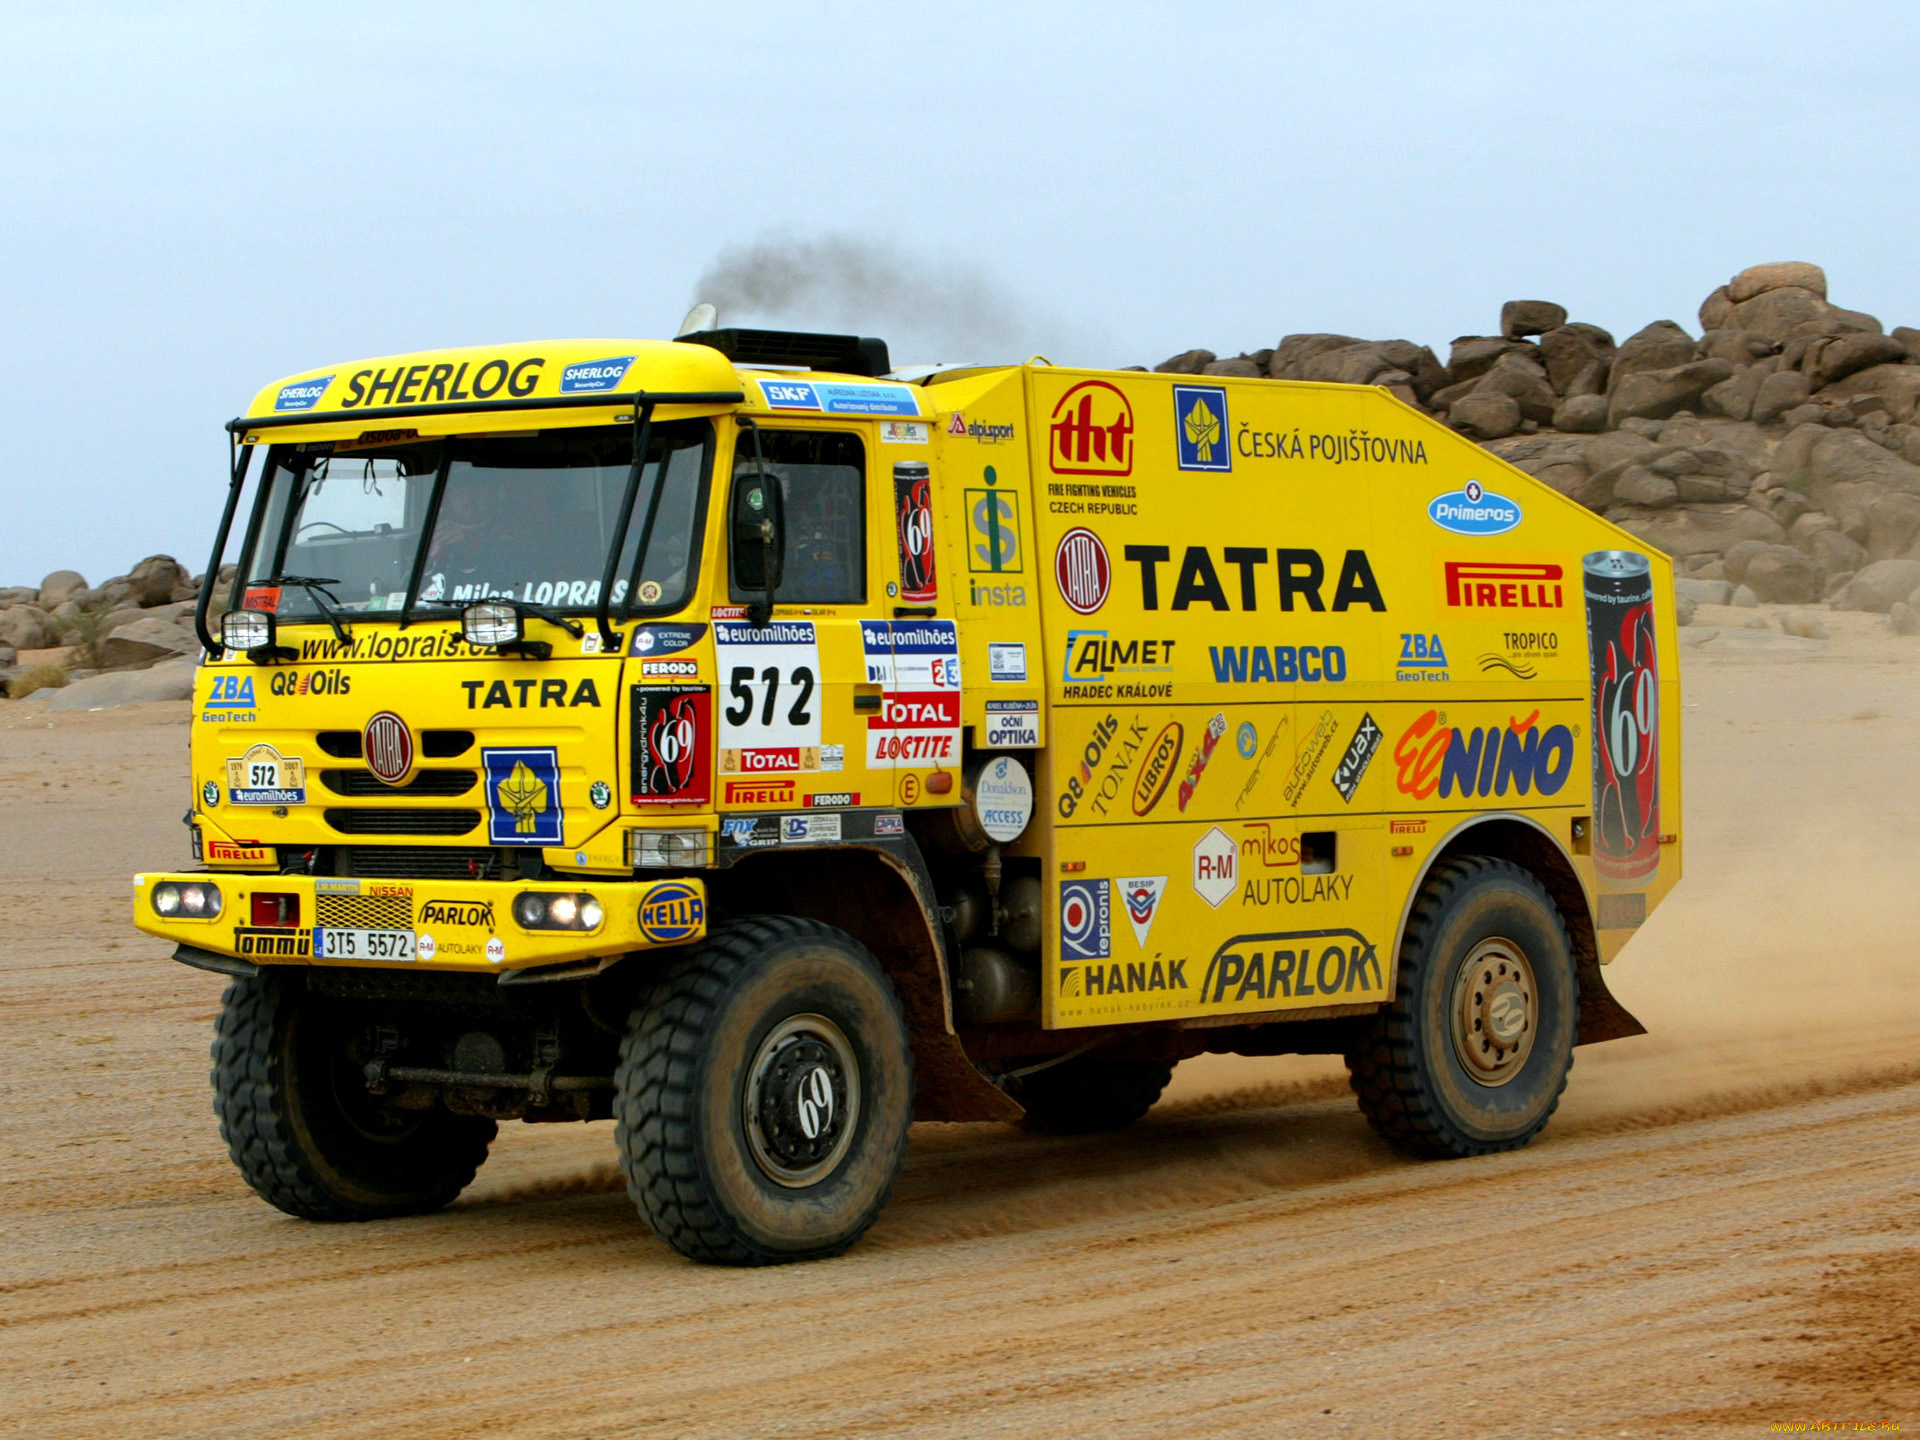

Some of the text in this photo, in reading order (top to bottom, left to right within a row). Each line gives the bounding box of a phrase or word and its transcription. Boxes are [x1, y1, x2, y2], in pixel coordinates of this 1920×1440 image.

[341, 358, 545, 408] SHERLOG
[564, 366, 624, 380] SHERLOG
[279, 386, 323, 399] SHERLOG
[768, 386, 810, 401] SKF
[1238, 422, 1428, 465] ČESKÁ POJIŠŤOVNA
[1048, 484, 1136, 498] FIRE FIGHTING VEHICLES
[1049, 501, 1138, 515] CZECH REPUBLIC
[1436, 503, 1514, 522] Primeros
[907, 508, 931, 555] 69
[1065, 537, 1100, 606] TATRA
[1124, 545, 1388, 613] TATRA
[970, 579, 1026, 606] insta
[1444, 561, 1564, 608] PIRELLI
[711, 607, 745, 618] LOCTITE
[658, 631, 691, 640] EXTREME
[730, 625, 814, 642] euromilhões
[876, 629, 955, 645] euromilhões
[1503, 632, 1558, 650] TROPICO
[1074, 640, 1176, 673] ALMET
[1399, 634, 1446, 660] ZBA
[642, 663, 697, 674] FERODO
[934, 666, 944, 683] 2
[1208, 646, 1347, 683] WABCO
[1396, 670, 1450, 681] GeoTech
[208, 676, 257, 702] ZBA
[271, 669, 351, 696] Q8 Oils
[461, 678, 602, 709] TATRA
[1063, 682, 1173, 699] HRADEC KRÁLOVÉ
[725, 667, 814, 726] 512
[202, 711, 256, 722] GeoTech
[881, 700, 952, 722] TOTAL
[1001, 715, 1023, 727] OČNÍ
[1611, 668, 1656, 778] 69
[370, 718, 402, 777] TATRA
[639, 697, 649, 794] energydrink4u
[660, 720, 693, 763] 69
[876, 736, 953, 760] LOCTITE
[988, 729, 1036, 745] OPTIKA
[742, 751, 799, 769] TOTAL
[1058, 713, 1118, 819] Q8 Oils
[1091, 714, 1150, 817] TONAK
[1283, 710, 1334, 802] autoweb
[1291, 720, 1339, 809] www.autoweb.cz
[251, 765, 276, 786] 512
[1137, 734, 1176, 803] LIBROS
[243, 790, 298, 801] euromilhões
[725, 780, 796, 804] PIRELLI
[981, 781, 1027, 795] Donaldson
[814, 795, 850, 806] FERODO
[721, 818, 759, 837] FOX
[983, 810, 1023, 824] ACCESS
[1390, 819, 1430, 834] PIRELLI
[208, 839, 265, 860] PIRELLI
[1198, 855, 1233, 881] R-M
[369, 886, 414, 897] NISSAN
[1128, 880, 1155, 888] BESIP
[1242, 875, 1354, 906] AUTOLAKY
[423, 906, 493, 927] PARLOK
[642, 899, 703, 926] HELLA
[1097, 881, 1111, 956] repronis
[326, 931, 408, 957] 3T5 5572
[419, 942, 504, 955] R-M AUTOLAKY R-M
[1085, 953, 1189, 996] HANÁK
[1213, 945, 1380, 1003] PARLOK
[798, 1067, 834, 1140] 69
